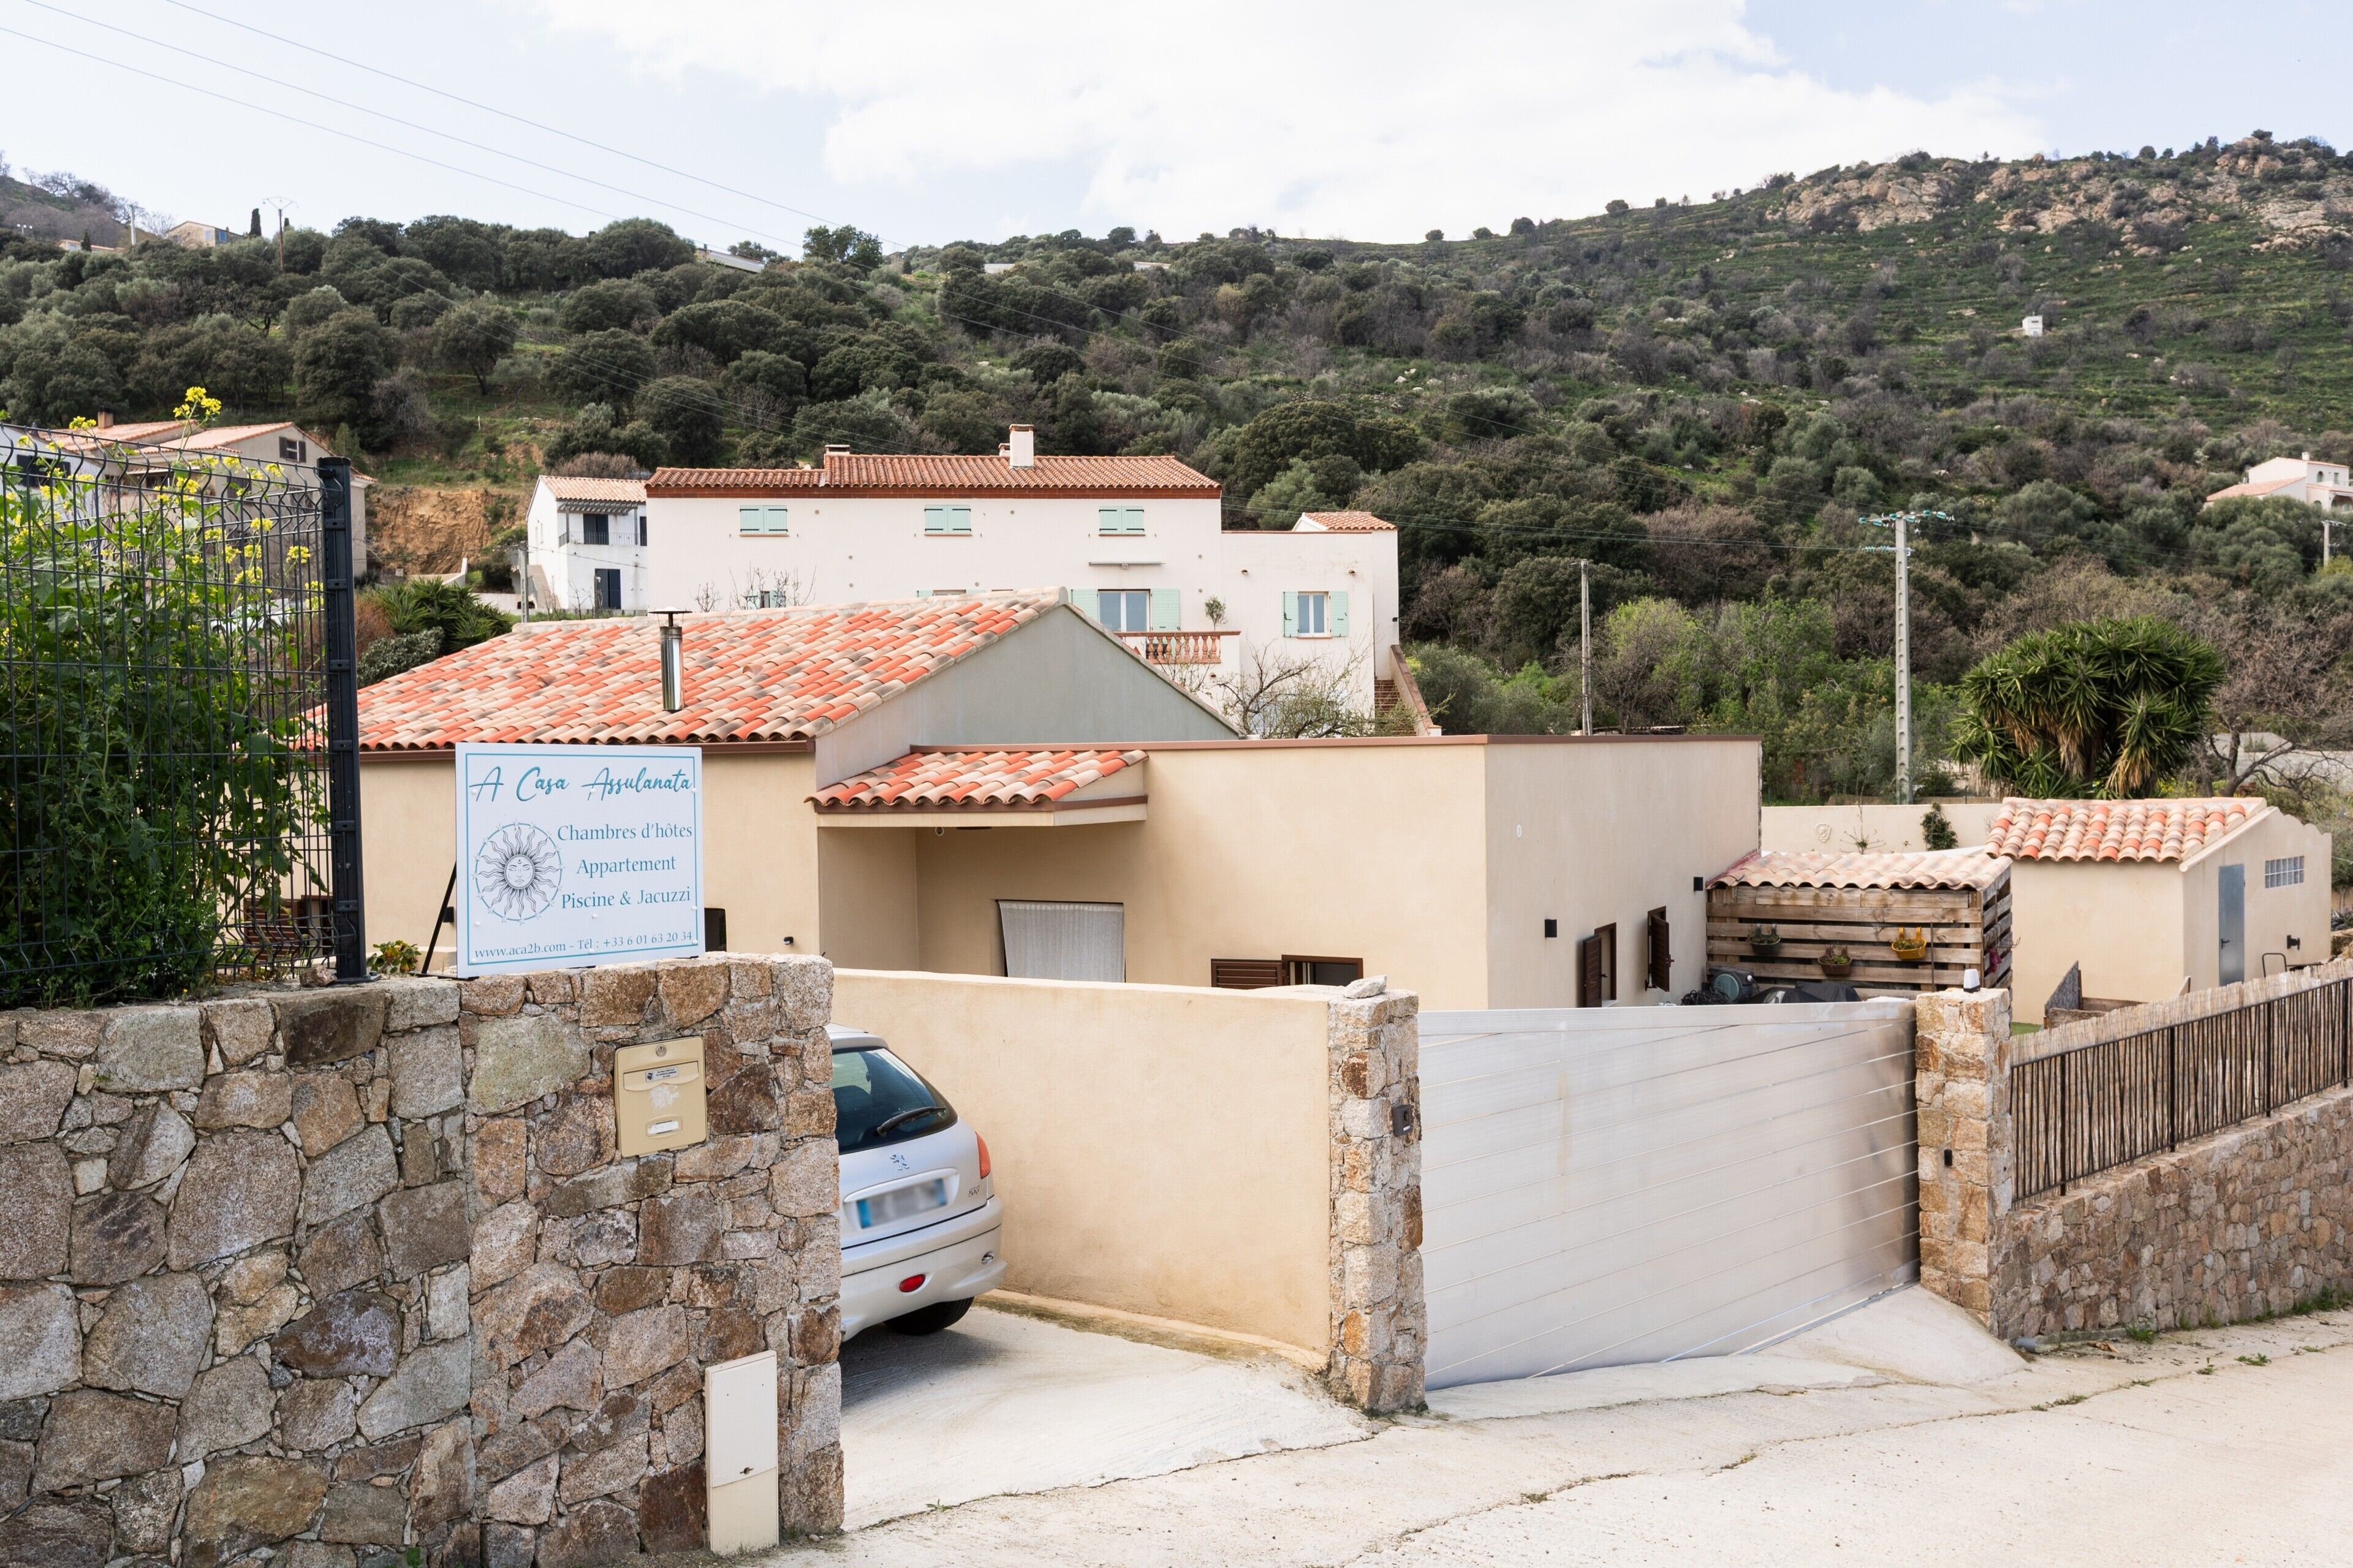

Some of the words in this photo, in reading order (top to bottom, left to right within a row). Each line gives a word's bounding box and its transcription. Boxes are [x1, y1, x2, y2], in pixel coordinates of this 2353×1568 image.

[469, 766, 504, 801] A
[516, 766, 569, 801] Casa
[582, 767, 693, 801] Assulanata
[558, 824, 636, 841] Chambres
[642, 823, 692, 838] d'hôtes
[576, 856, 676, 878] Appartement
[561, 892, 615, 909] Piscine
[620, 891, 631, 905] &
[637, 886, 691, 904] Jacuzzi
[475, 943, 566, 958] www.aca2b.com
[577, 939, 592, 949] Tél
[604, 937, 623, 947] +33
[627, 936, 633, 945] 6
[636, 935, 647, 944] 01
[651, 933, 663, 943] 63
[667, 932, 678, 942] 20
[681, 931, 692, 941] 34
